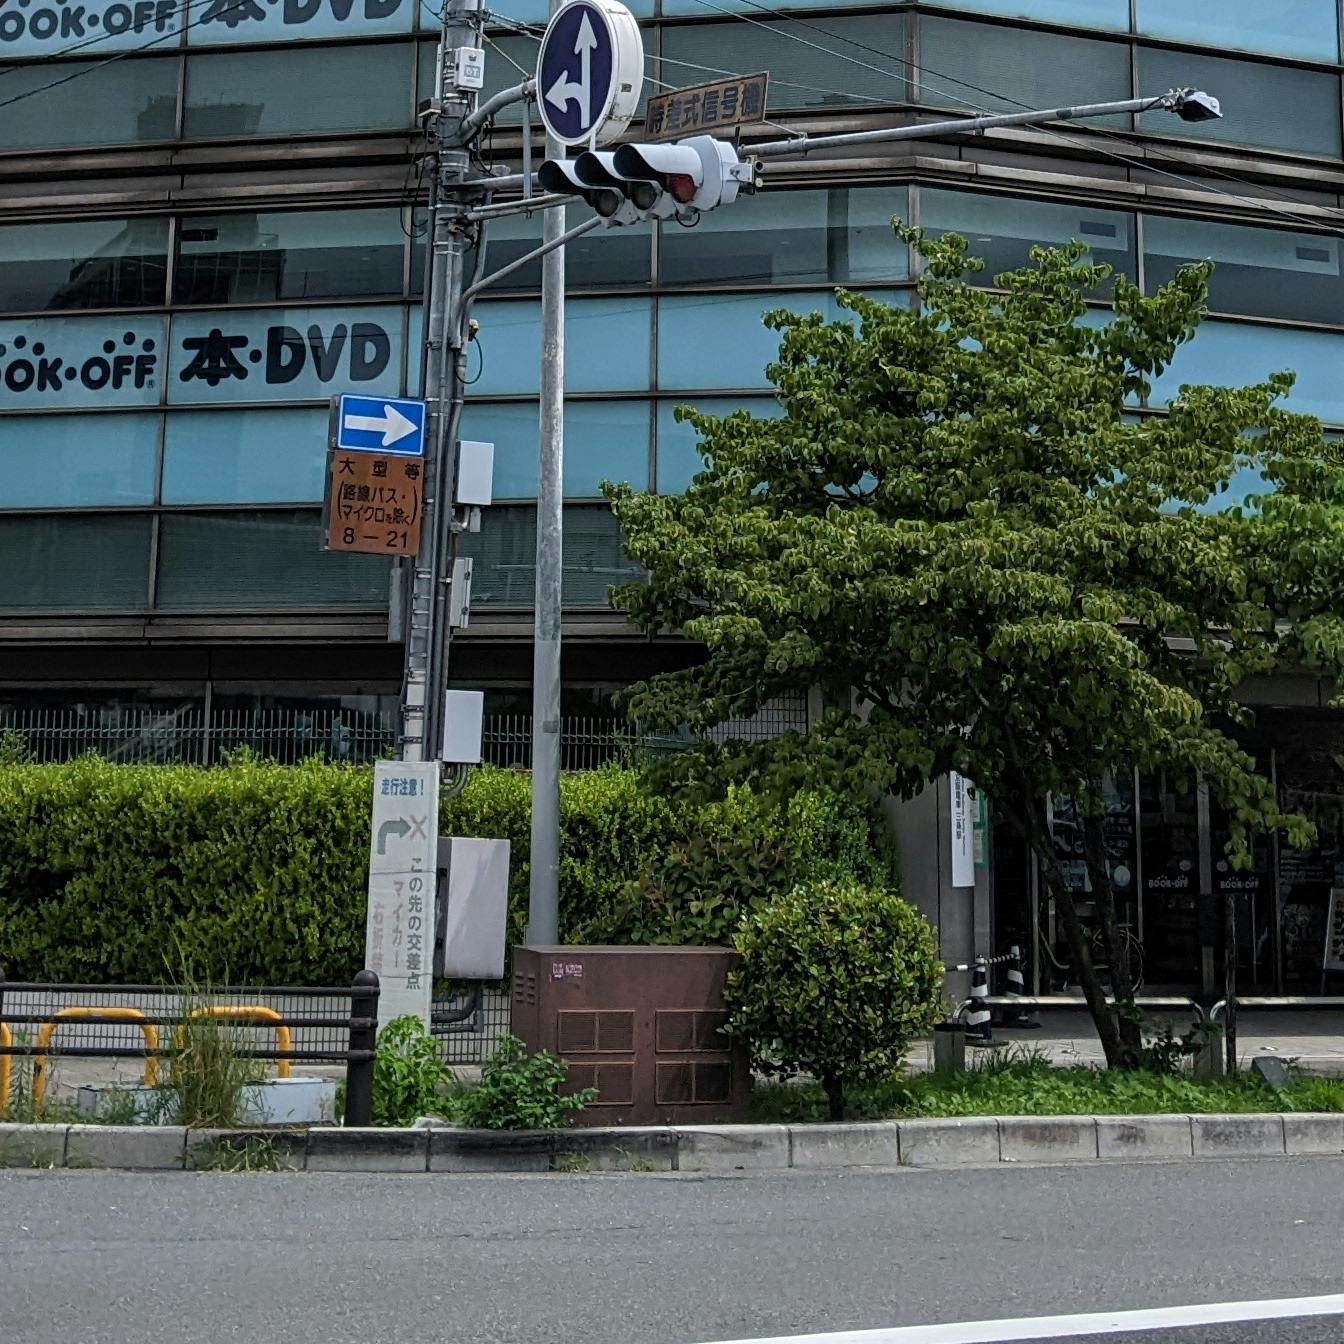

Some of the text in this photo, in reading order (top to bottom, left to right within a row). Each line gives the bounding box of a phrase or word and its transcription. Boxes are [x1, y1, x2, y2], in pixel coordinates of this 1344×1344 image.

[649, 82, 762, 135] 時差式信号機
[338, 459, 421, 481] 大型等
[406, 857, 424, 990] この先の交差点
